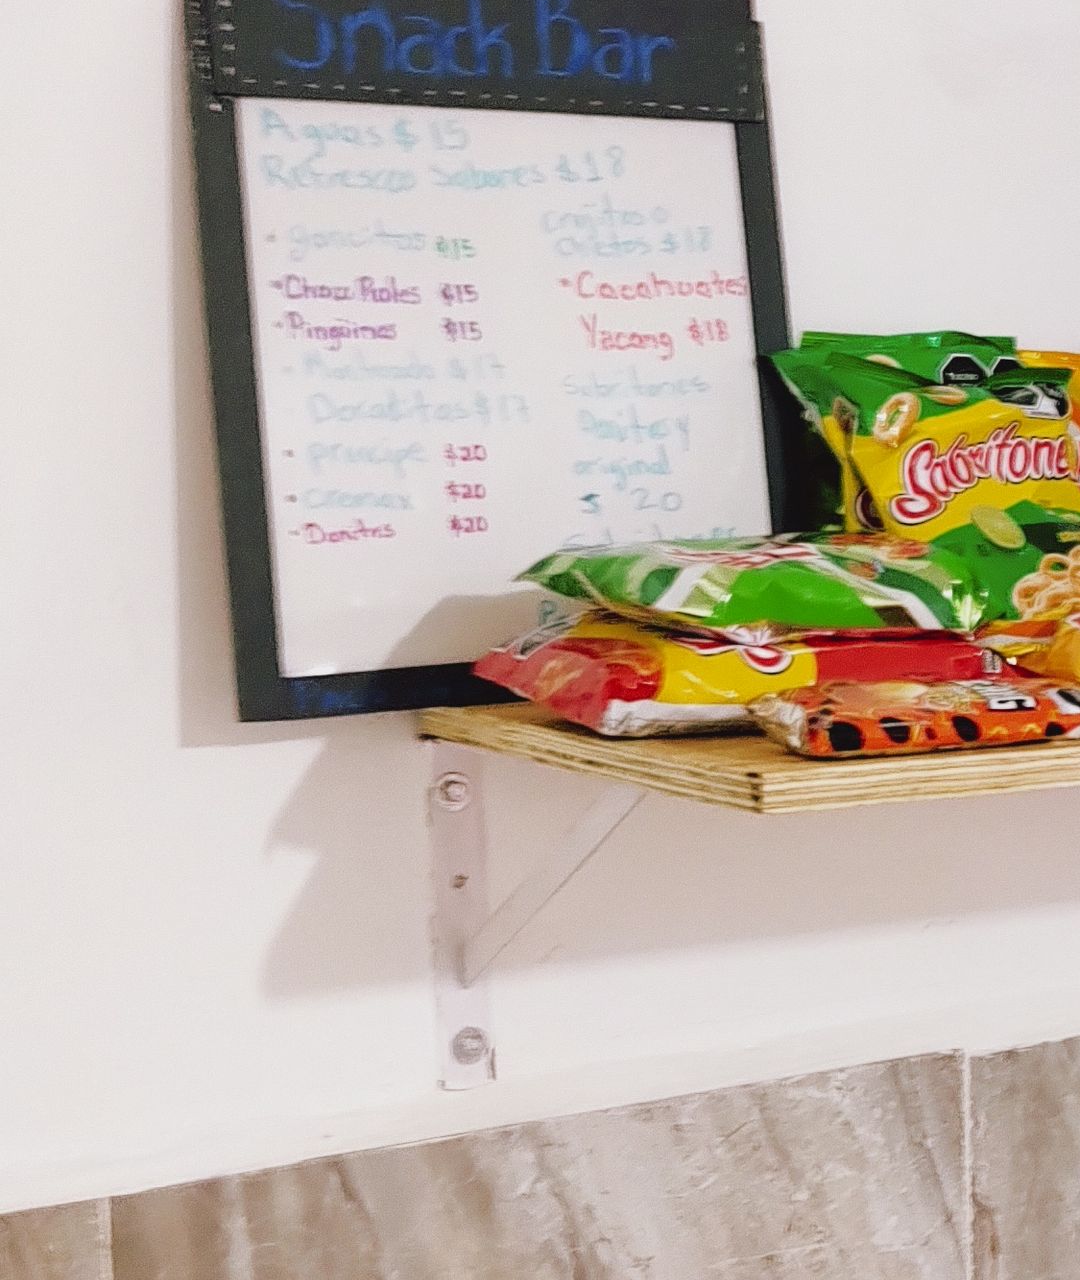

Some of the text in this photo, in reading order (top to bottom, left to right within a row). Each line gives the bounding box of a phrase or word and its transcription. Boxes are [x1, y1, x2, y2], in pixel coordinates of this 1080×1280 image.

[439, 282, 480, 306] $15
[441, 317, 483, 342] $15
[444, 442, 487, 467] $20
[890, 421, 1069, 526] Sabritone
[445, 481, 487, 503] $20
[449, 514, 488, 538] $20
